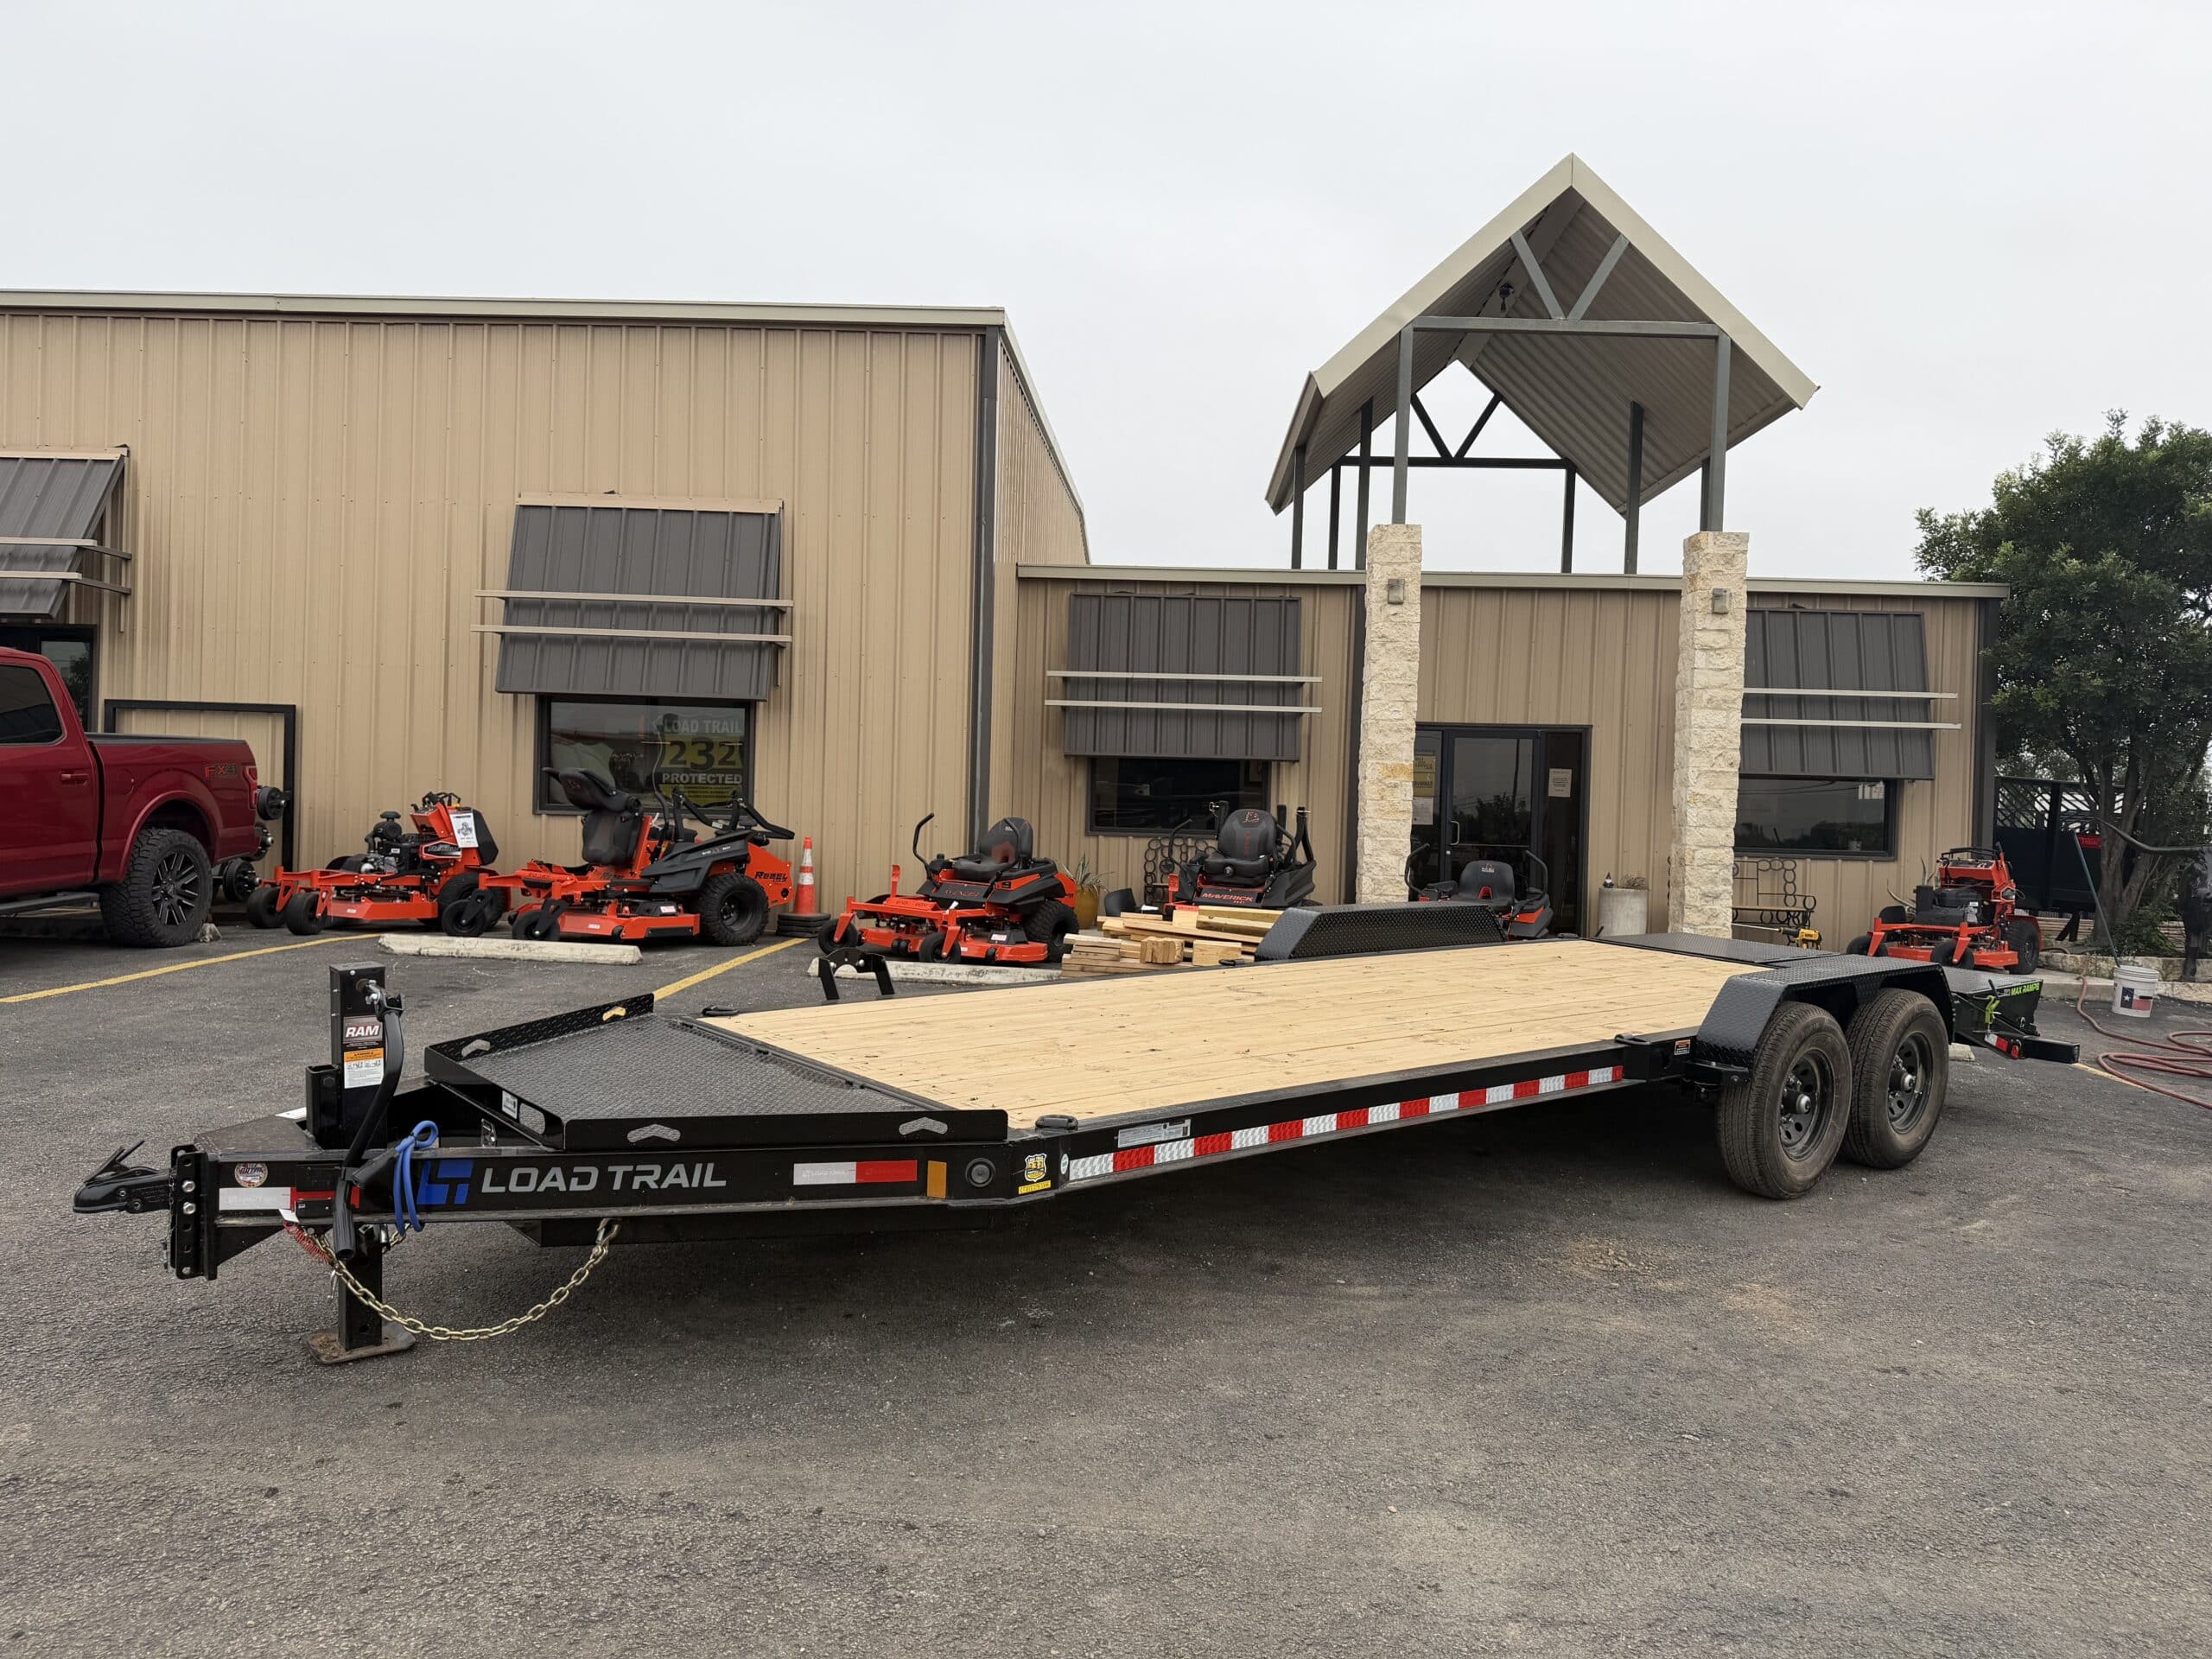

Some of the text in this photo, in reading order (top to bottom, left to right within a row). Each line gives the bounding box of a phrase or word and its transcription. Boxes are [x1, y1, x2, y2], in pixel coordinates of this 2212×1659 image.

[664, 719, 743, 734] LOAD TRAIL
[669, 737, 737, 771] 232
[204, 764, 237, 778] FX4
[662, 772, 743, 785] PROTECTED
[1202, 893, 1255, 902] MAVERICK
[346, 1025, 380, 1038] RAM
[481, 1166, 599, 1193] LOAD
[607, 1162, 727, 1190] TRAIL
